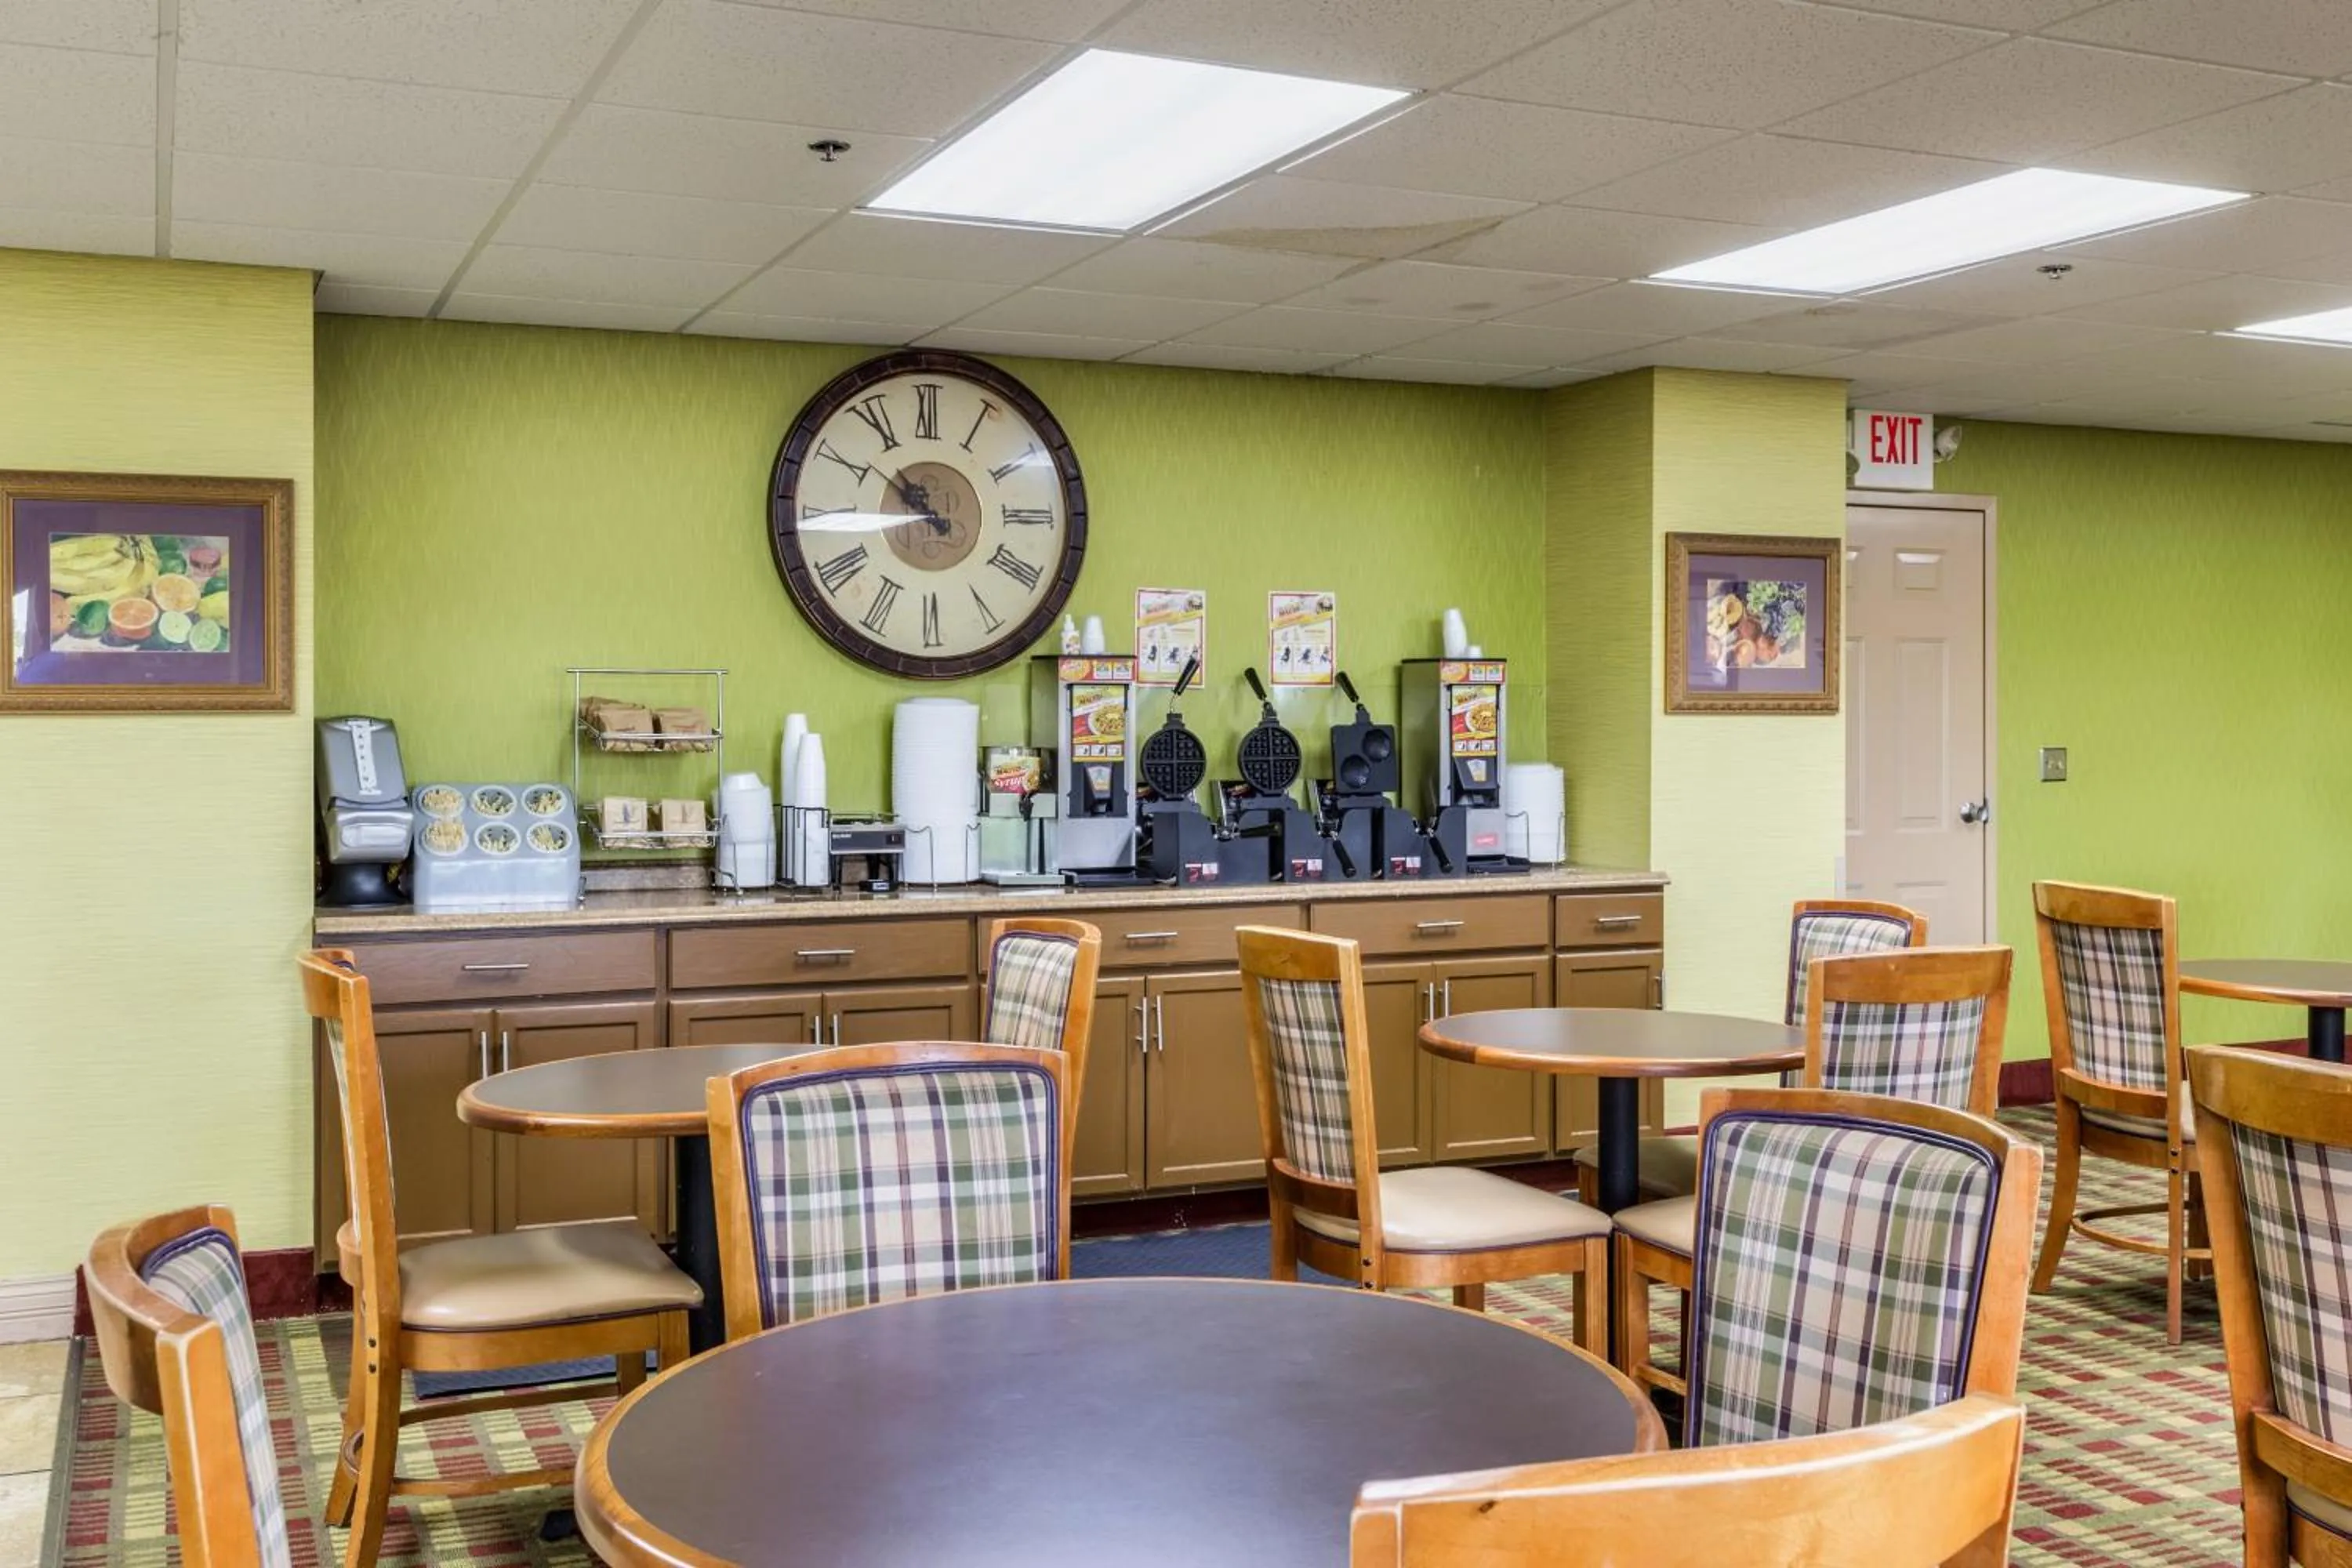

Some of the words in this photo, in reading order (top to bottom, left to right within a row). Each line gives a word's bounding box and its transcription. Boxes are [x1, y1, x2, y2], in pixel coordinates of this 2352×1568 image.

[844, 394, 902, 453] XI
[913, 384, 943, 441] XII
[1870, 415, 1923, 465] EXIT
